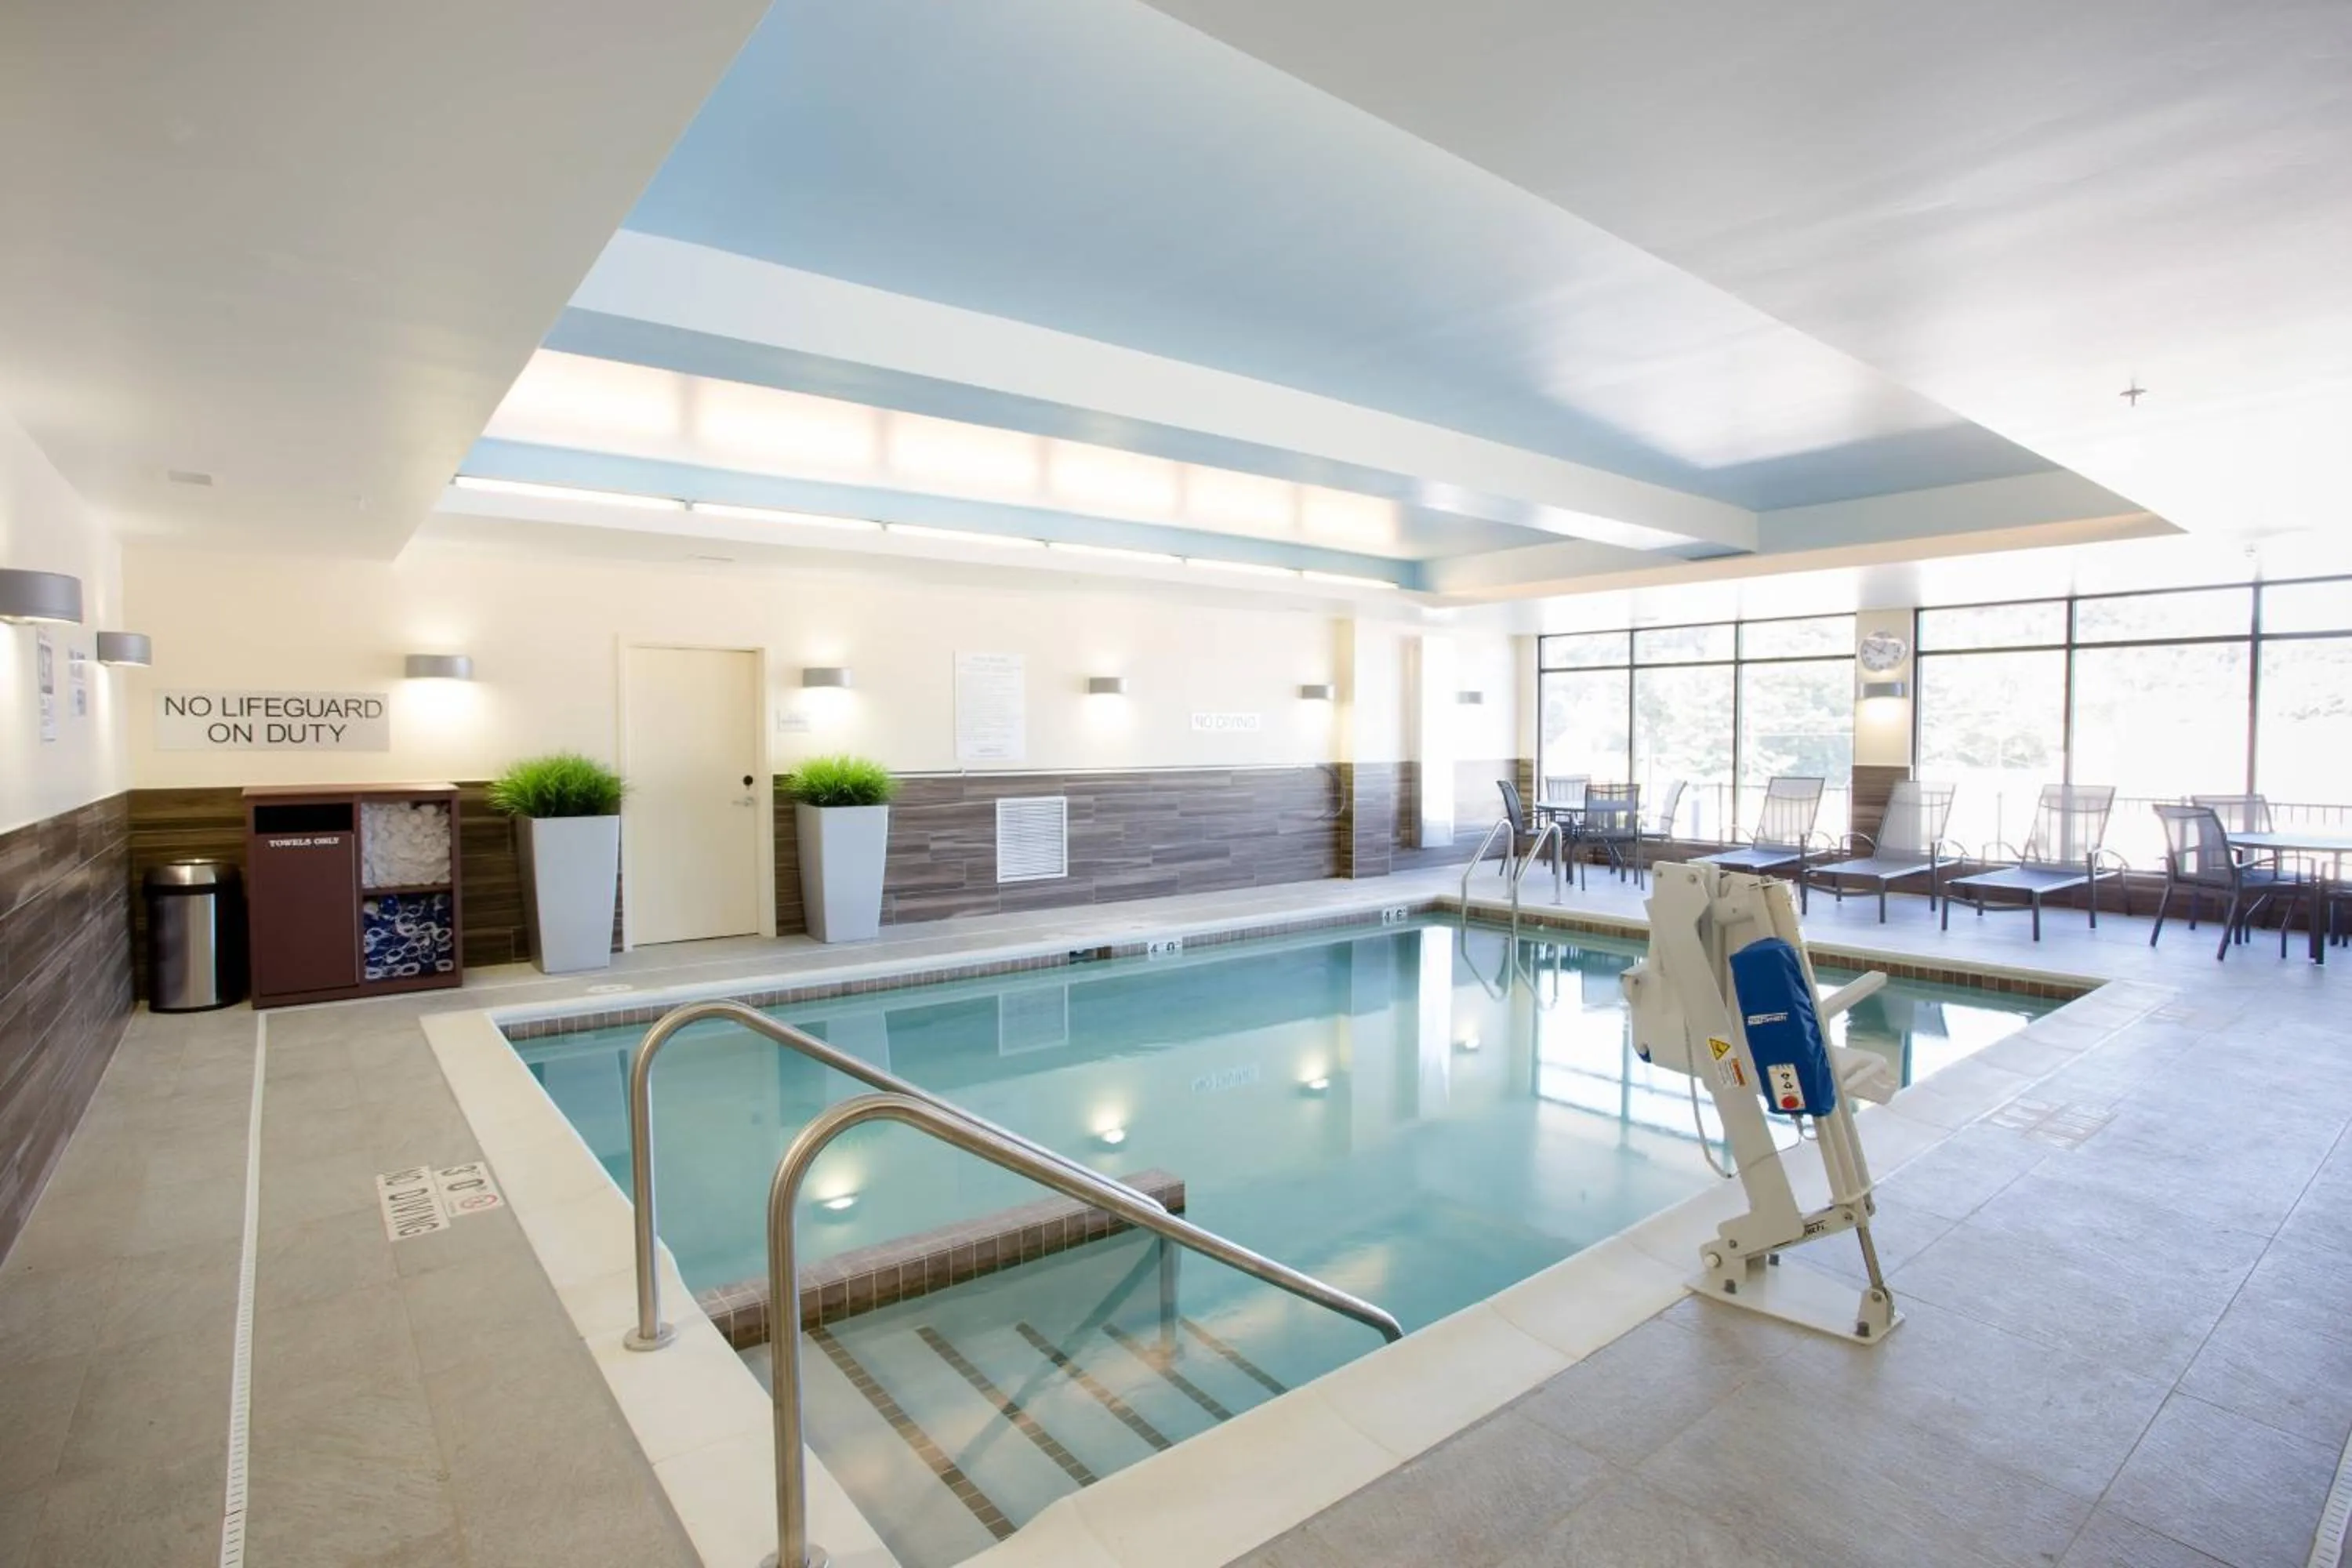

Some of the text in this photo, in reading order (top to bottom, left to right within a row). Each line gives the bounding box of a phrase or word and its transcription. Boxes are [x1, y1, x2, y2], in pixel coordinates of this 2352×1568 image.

[165, 695, 383, 720] NO LIFEGUARD
[207, 722, 347, 743] ON DUTY
[268, 837, 339, 848] TOWELS ONLY
[388, 1187, 440, 1236] DIVING
